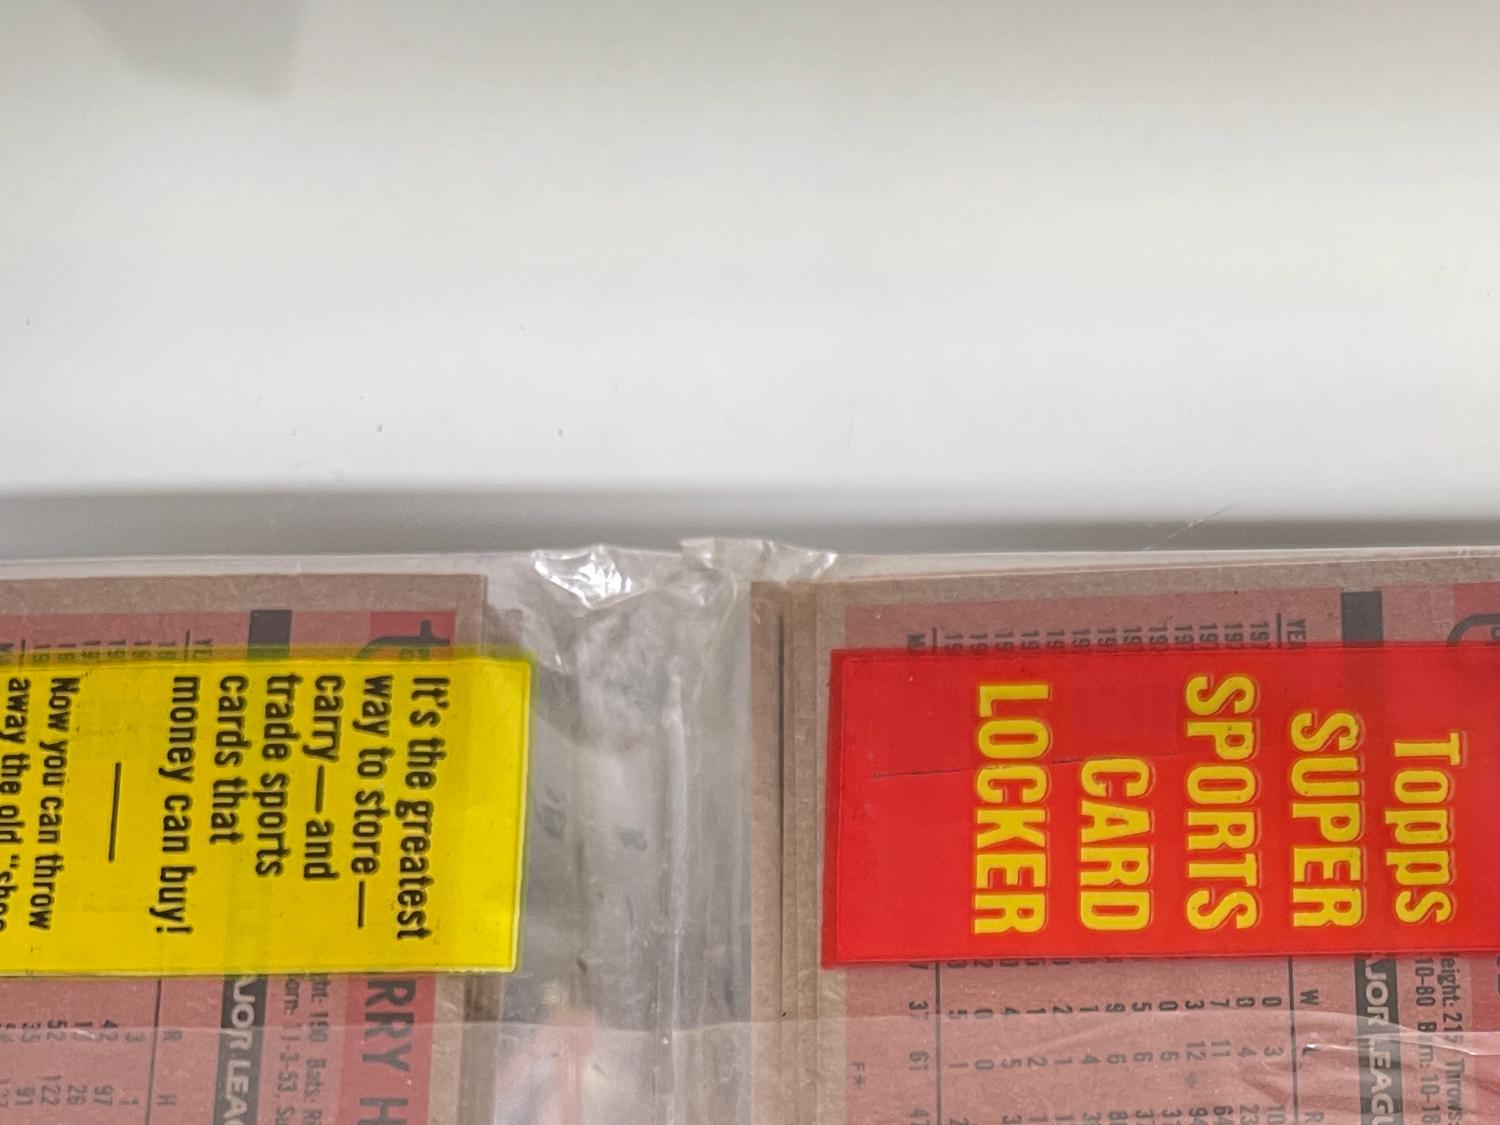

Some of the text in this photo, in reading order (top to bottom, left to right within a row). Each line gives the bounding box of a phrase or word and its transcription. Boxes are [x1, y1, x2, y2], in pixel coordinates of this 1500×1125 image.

[0, 677, 32, 743] away
[1, 754, 30, 794] the
[209, 675, 253, 844] cards that
[252, 674, 302, 877] trade sports
[352, 675, 394, 736] way
[359, 747, 394, 778] to
[28, 677, 80, 931] Now you can throw
[149, 675, 200, 935] money can buy!
[396, 677, 450, 941] It's the greatest
[971, 683, 1051, 934] LOCKER
[1079, 757, 1152, 932] CARD
[1184, 674, 1260, 930] SPORTS
[1289, 711, 1362, 928] SUPER
[1384, 731, 1462, 925] Topps
[304, 1057, 327, 1102] Bats:
[362, 979, 417, 1072] RRY
[1446, 1060, 1466, 1125] Throws:
[1239, 1104, 1259, 1125] 23
